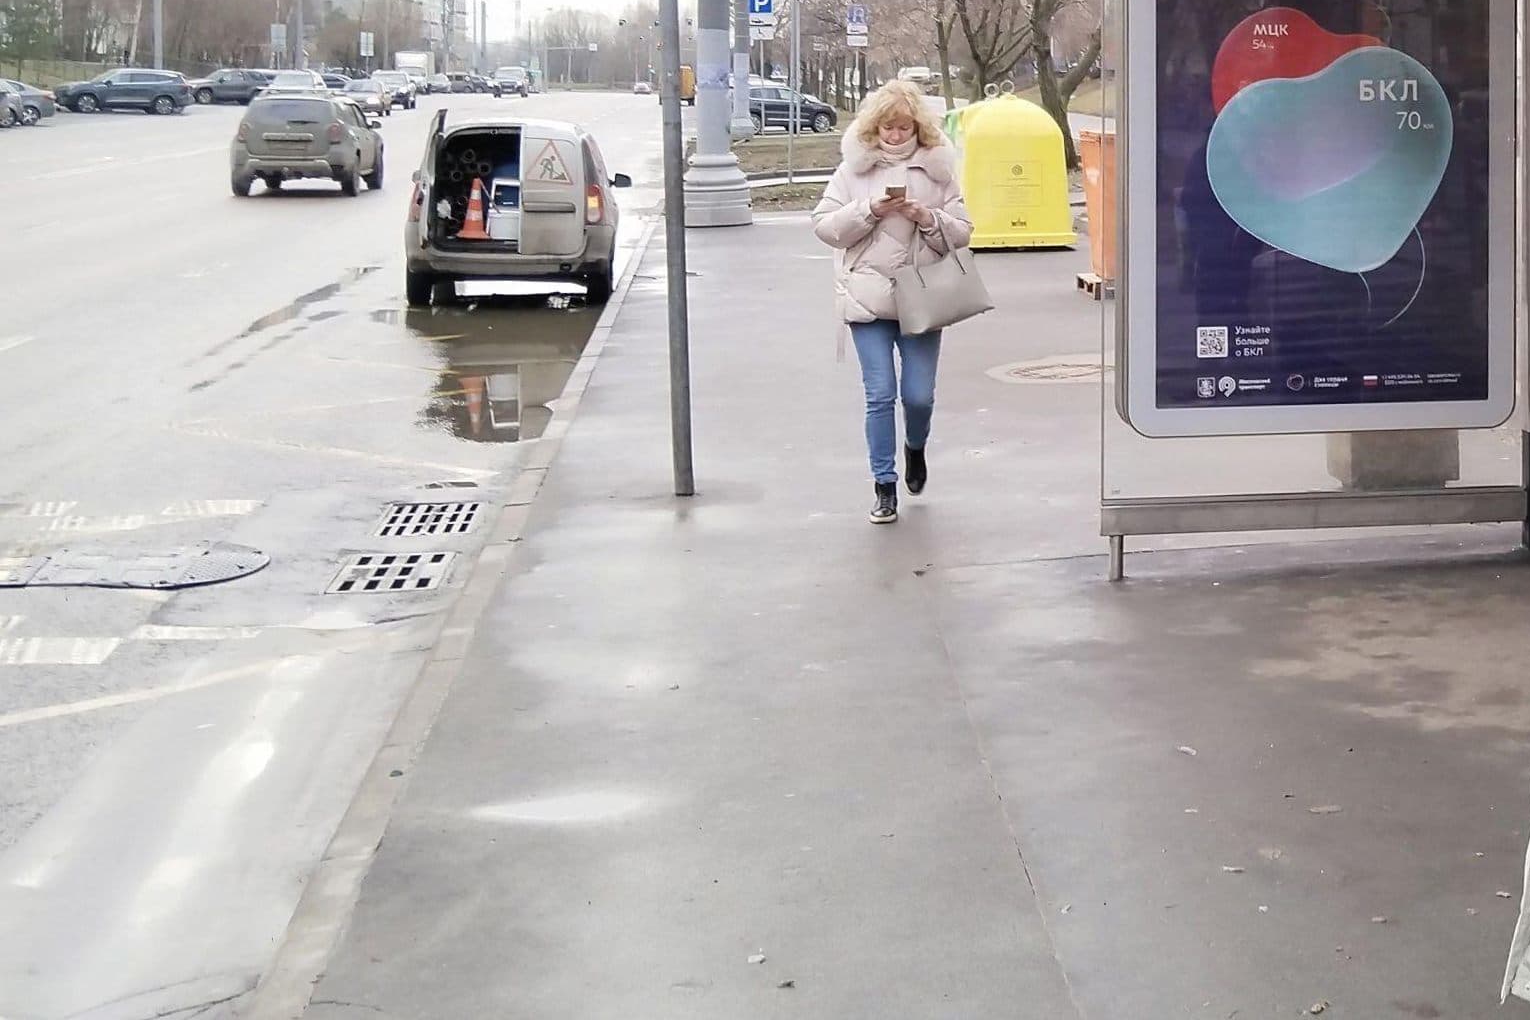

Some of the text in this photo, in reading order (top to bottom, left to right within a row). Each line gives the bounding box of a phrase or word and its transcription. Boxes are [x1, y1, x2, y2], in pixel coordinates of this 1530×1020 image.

[1253, 23, 1290, 38] МЦК
[1251, 38, 1267, 50] 54
[1359, 79, 1419, 102] БКЛ
[1396, 111, 1421, 130] 70
[1234, 325, 1272, 335] Узнайте
[1235, 337, 1271, 346] больше
[1243, 347, 1264, 357] БКЛ
